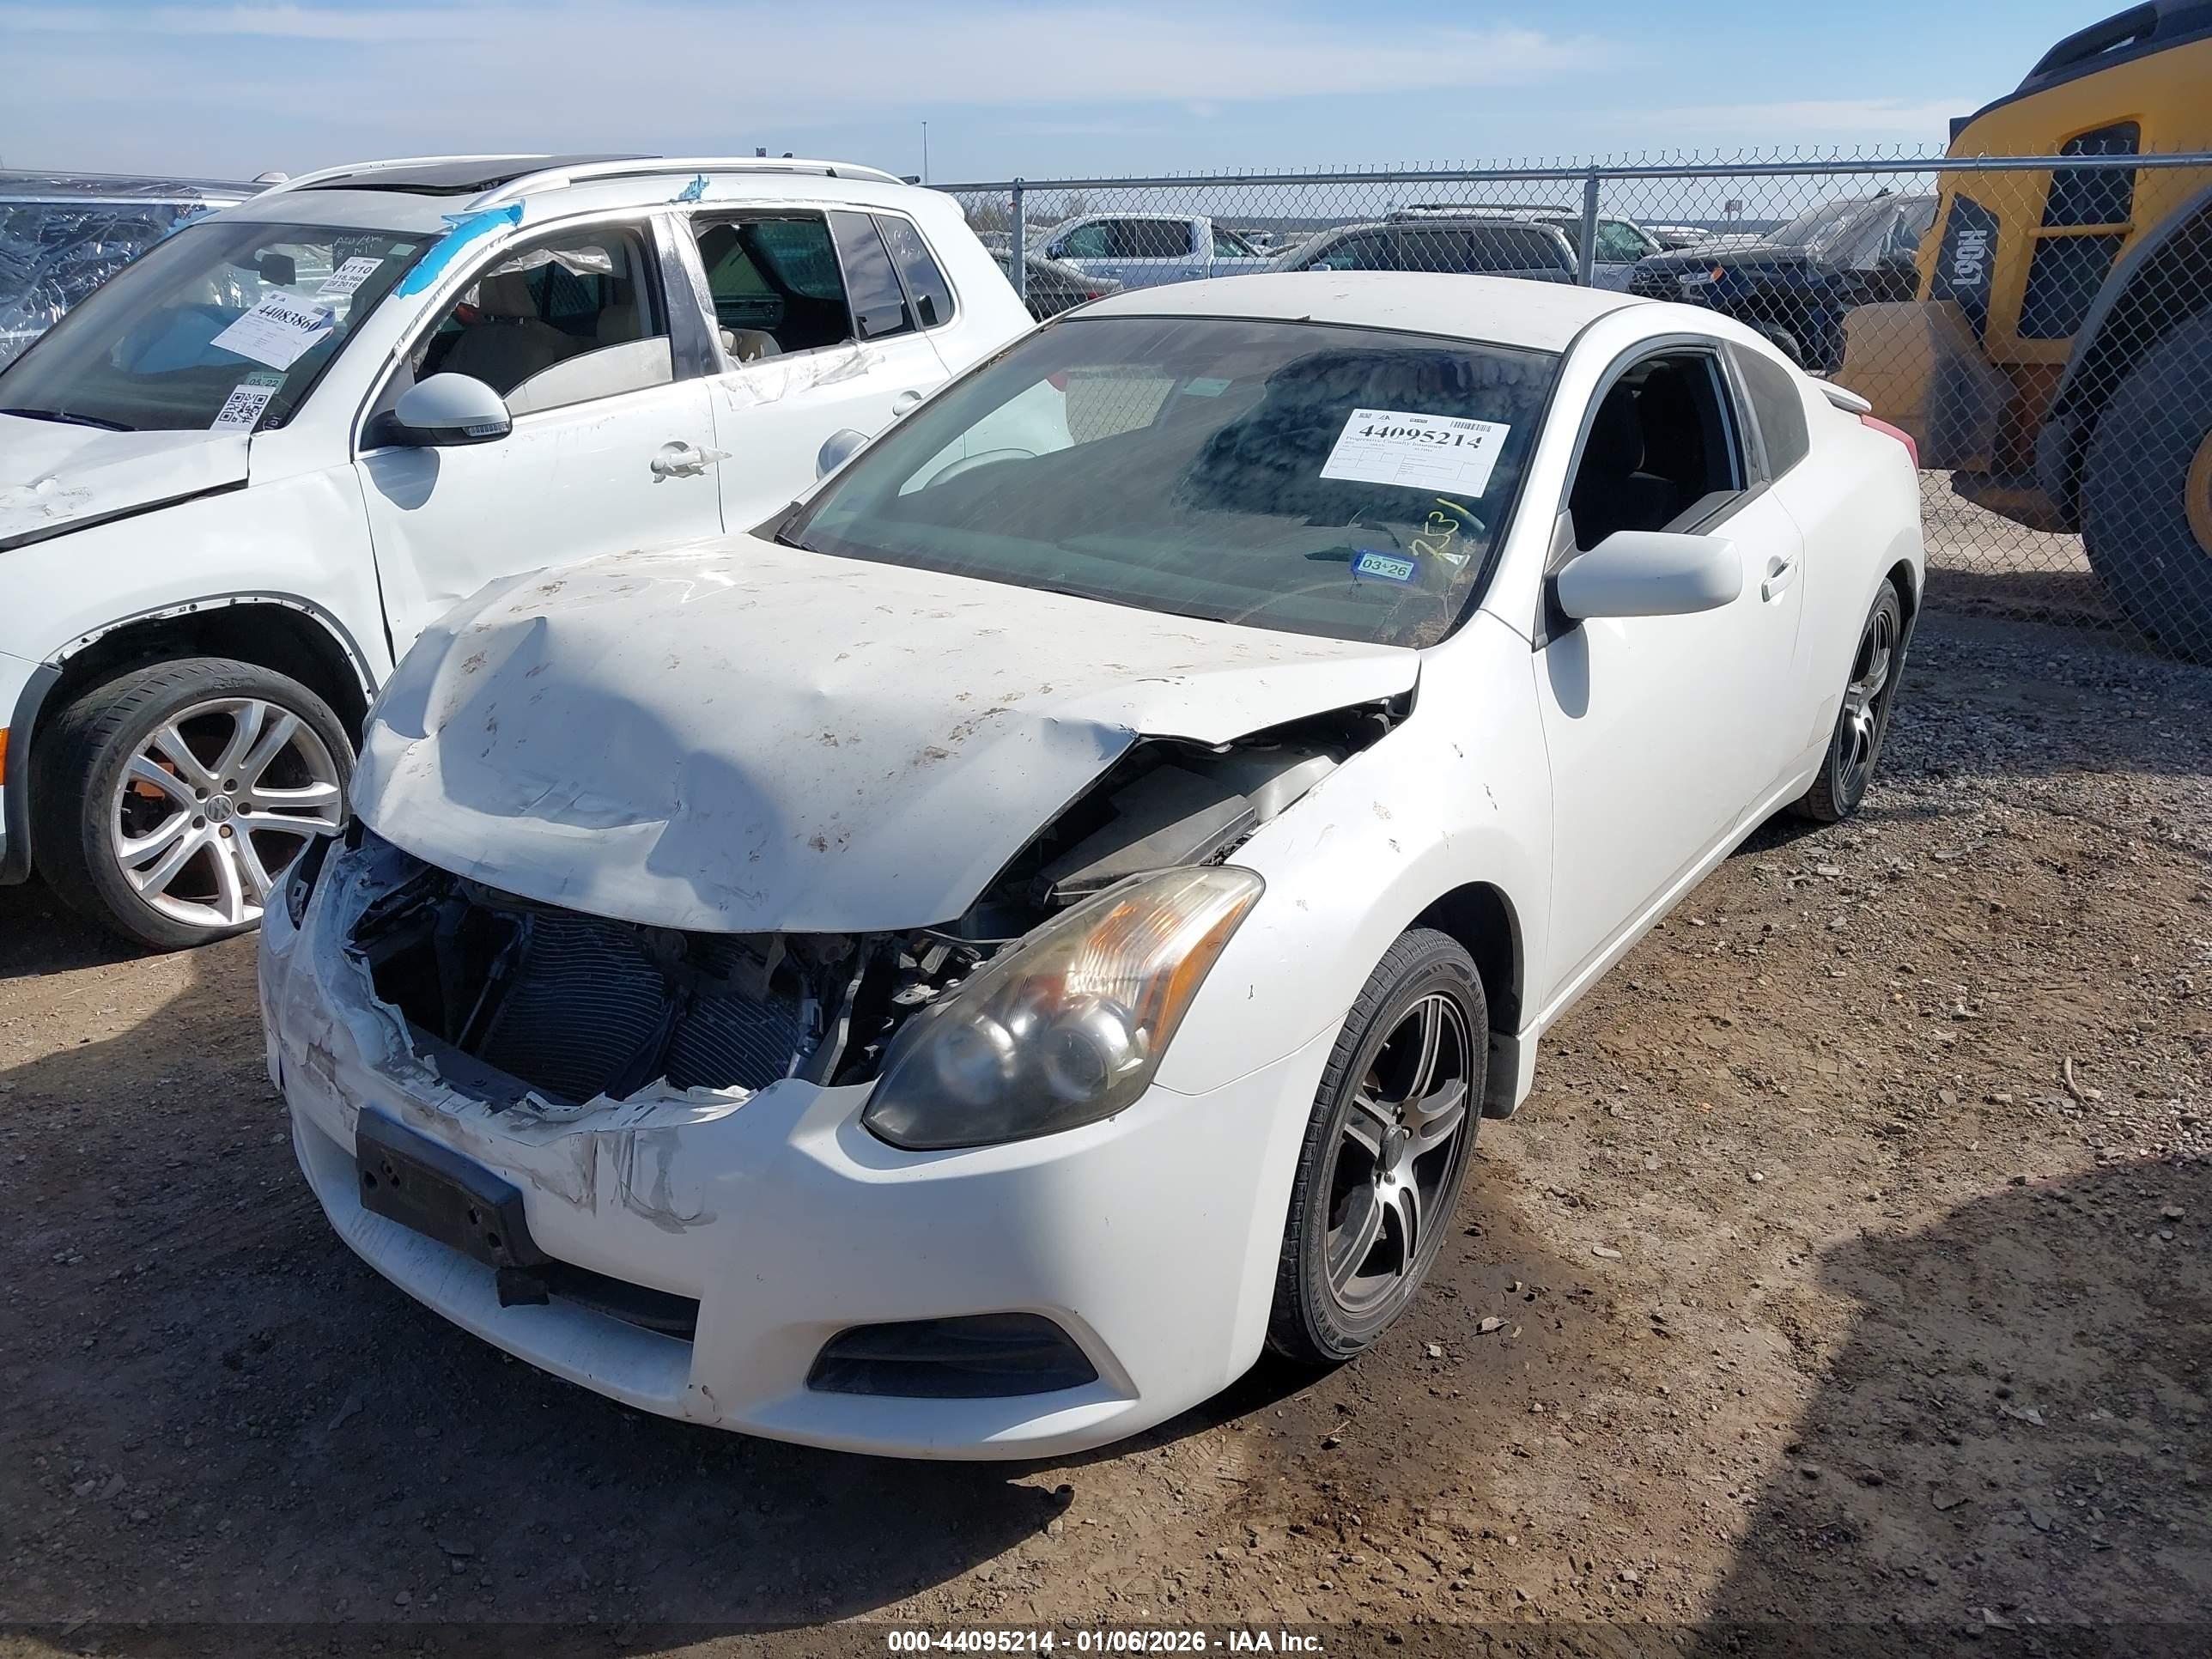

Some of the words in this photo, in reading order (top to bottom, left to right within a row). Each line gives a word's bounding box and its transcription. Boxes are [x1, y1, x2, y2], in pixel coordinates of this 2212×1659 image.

[342, 264, 373, 274] V110
[258, 304, 322, 332] 44083860
[1358, 424, 1483, 449] 44095214
[1362, 559, 1382, 571] 03
[1388, 564, 1408, 576] 26
